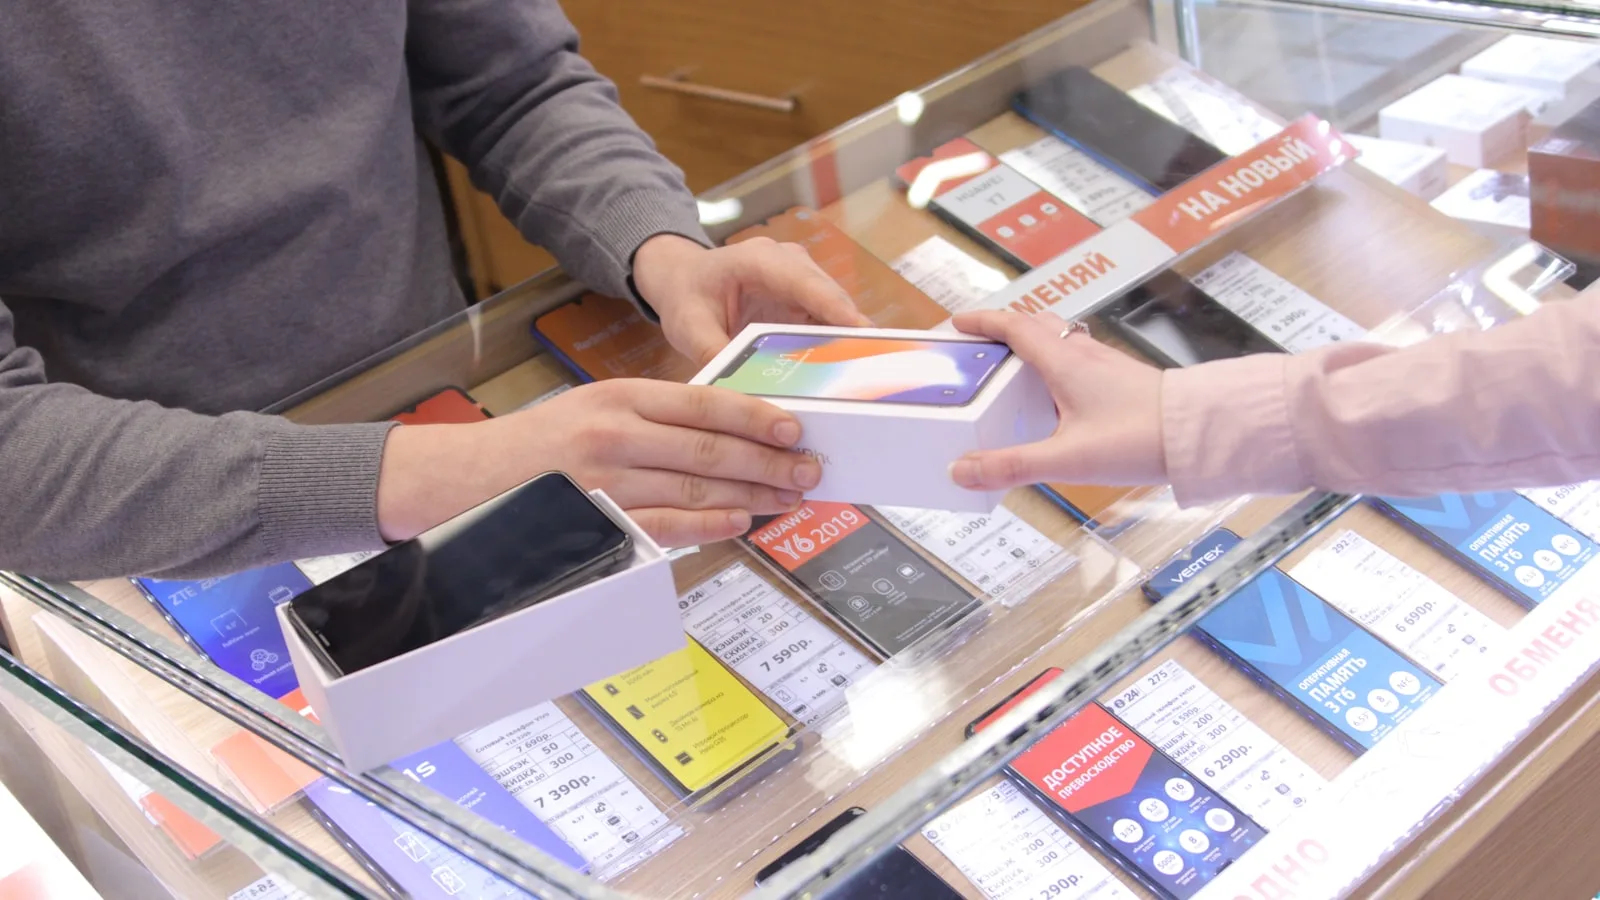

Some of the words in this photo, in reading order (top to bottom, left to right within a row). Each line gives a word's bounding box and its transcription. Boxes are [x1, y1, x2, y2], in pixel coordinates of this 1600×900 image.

[956, 174, 1004, 202] HUAWEI
[1178, 190, 1230, 222] НА
[1218, 136, 1317, 199] НОВЫЙ
[986, 194, 1006, 206] Y7
[1005, 250, 1118, 314] МЕНЯЙ
[759, 507, 815, 544] HUAWEI
[773, 534, 815, 560] Y6
[810, 510, 859, 544] 2019
[1469, 514, 1515, 551] ОПЕРАТИВНАЯ
[1479, 522, 1530, 562] ПАМЯТЬ
[1332, 539, 1350, 554] 292
[1171, 545, 1224, 584] VERTEX
[168, 586, 198, 607] ZTE
[687, 592, 703, 604] 24
[713, 628, 750, 653] КЭШБЭК
[759, 612, 773, 625] 20
[1395, 624, 1406, 633] 6
[1404, 601, 1436, 626] 690р.
[724, 636, 758, 661] СКИДКА
[768, 620, 789, 636] 300
[760, 662, 771, 672] 7
[772, 639, 812, 664] 590р.
[1124, 689, 1139, 701] 24
[1148, 670, 1168, 687] 275
[1298, 648, 1350, 690] ОПЕРАТИВНАЯ
[1308, 656, 1368, 702] ПАМЯТЬ
[1172, 718, 1180, 726] 6
[1180, 706, 1202, 722] 590р.
[1324, 700, 1341, 714] 3
[475, 734, 505, 754] Сотовый
[504, 719, 534, 740] телефон
[523, 733, 552, 750] 690р.
[1161, 731, 1188, 752] ЭШБЭК
[1192, 713, 1214, 729] 200
[1171, 740, 1197, 760] КИДКА
[1207, 724, 1228, 740] 300
[495, 758, 530, 781] ЭШБЭК
[542, 742, 559, 756] 50
[503, 768, 538, 790] КИДКА
[550, 752, 574, 770] 300
[1042, 725, 1124, 790] ДОСТУПНОЕ
[1058, 739, 1136, 800] ПРЕВОСХОДСТВО
[1204, 767, 1216, 779] 6
[1214, 744, 1252, 770] 290р.
[534, 797, 545, 809] 7
[548, 774, 596, 801] 390р.
[1172, 782, 1185, 794] 16
[1026, 838, 1044, 856] 200
[1120, 824, 1138, 838] 3/32
[1188, 836, 1198, 844] 8
[1038, 851, 1058, 868] 300
[1157, 854, 1176, 870] 5000
